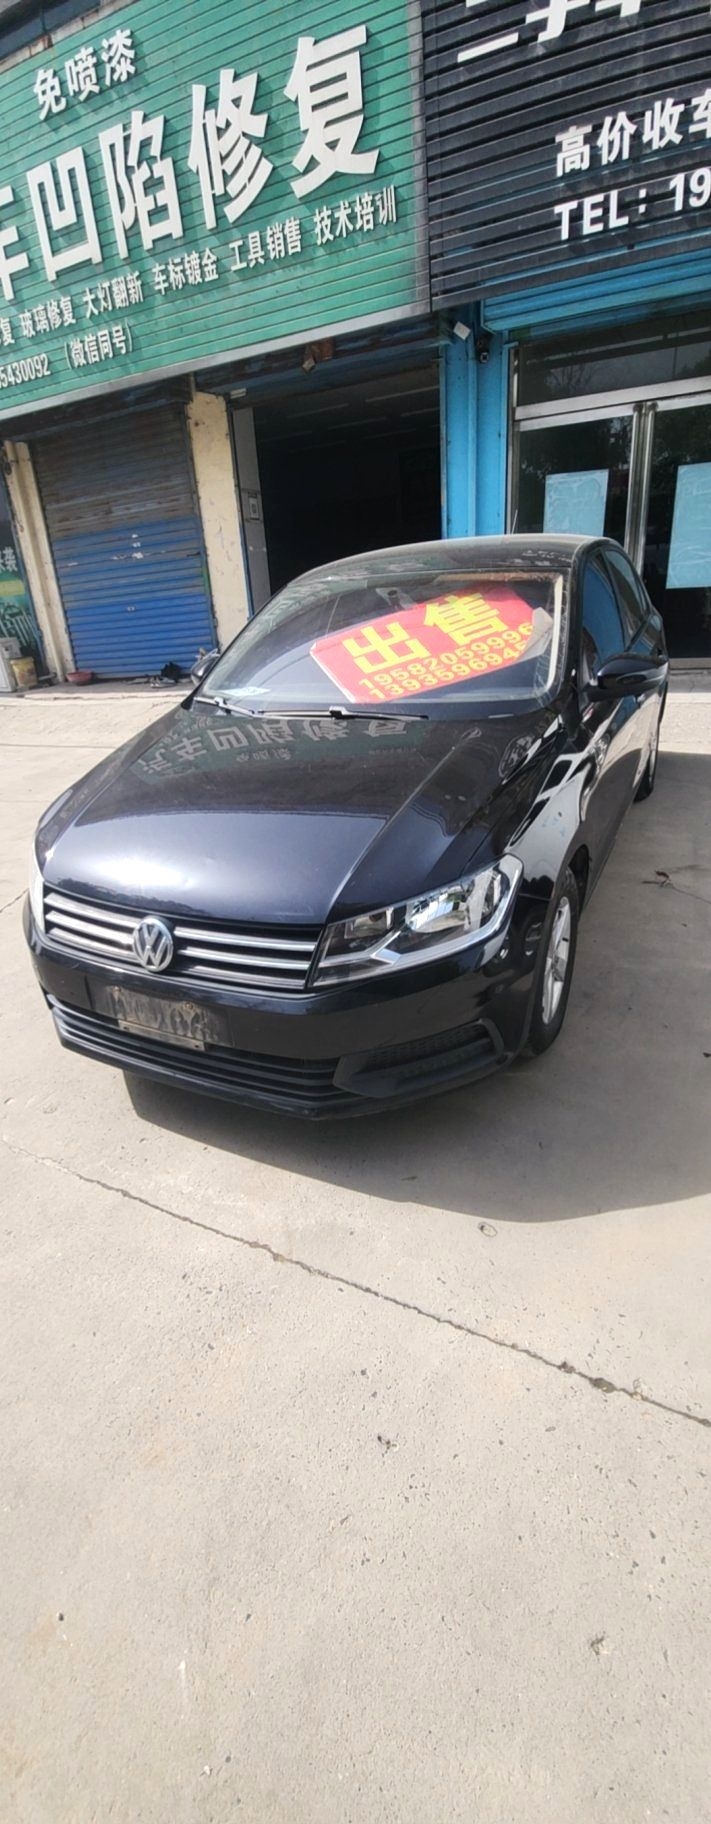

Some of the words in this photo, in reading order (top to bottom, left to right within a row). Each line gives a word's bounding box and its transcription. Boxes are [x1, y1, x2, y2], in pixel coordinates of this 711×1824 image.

[457, 0, 641, 62] 二手
[33, 28, 137, 120] 免喷漆
[555, 87, 711, 177] 高价收车
[669, 167, 711, 212] 19
[19, 295, 76, 338] 玻璃修复
[82, 271, 144, 319] 大灯翻新
[151, 247, 219, 296] 车标镀金
[229, 216, 302, 272] 工具销售
[313, 184, 397, 246] 技术培训
[342, 592, 508, 674] 出售
[359, 622, 533, 689] 19582059996
